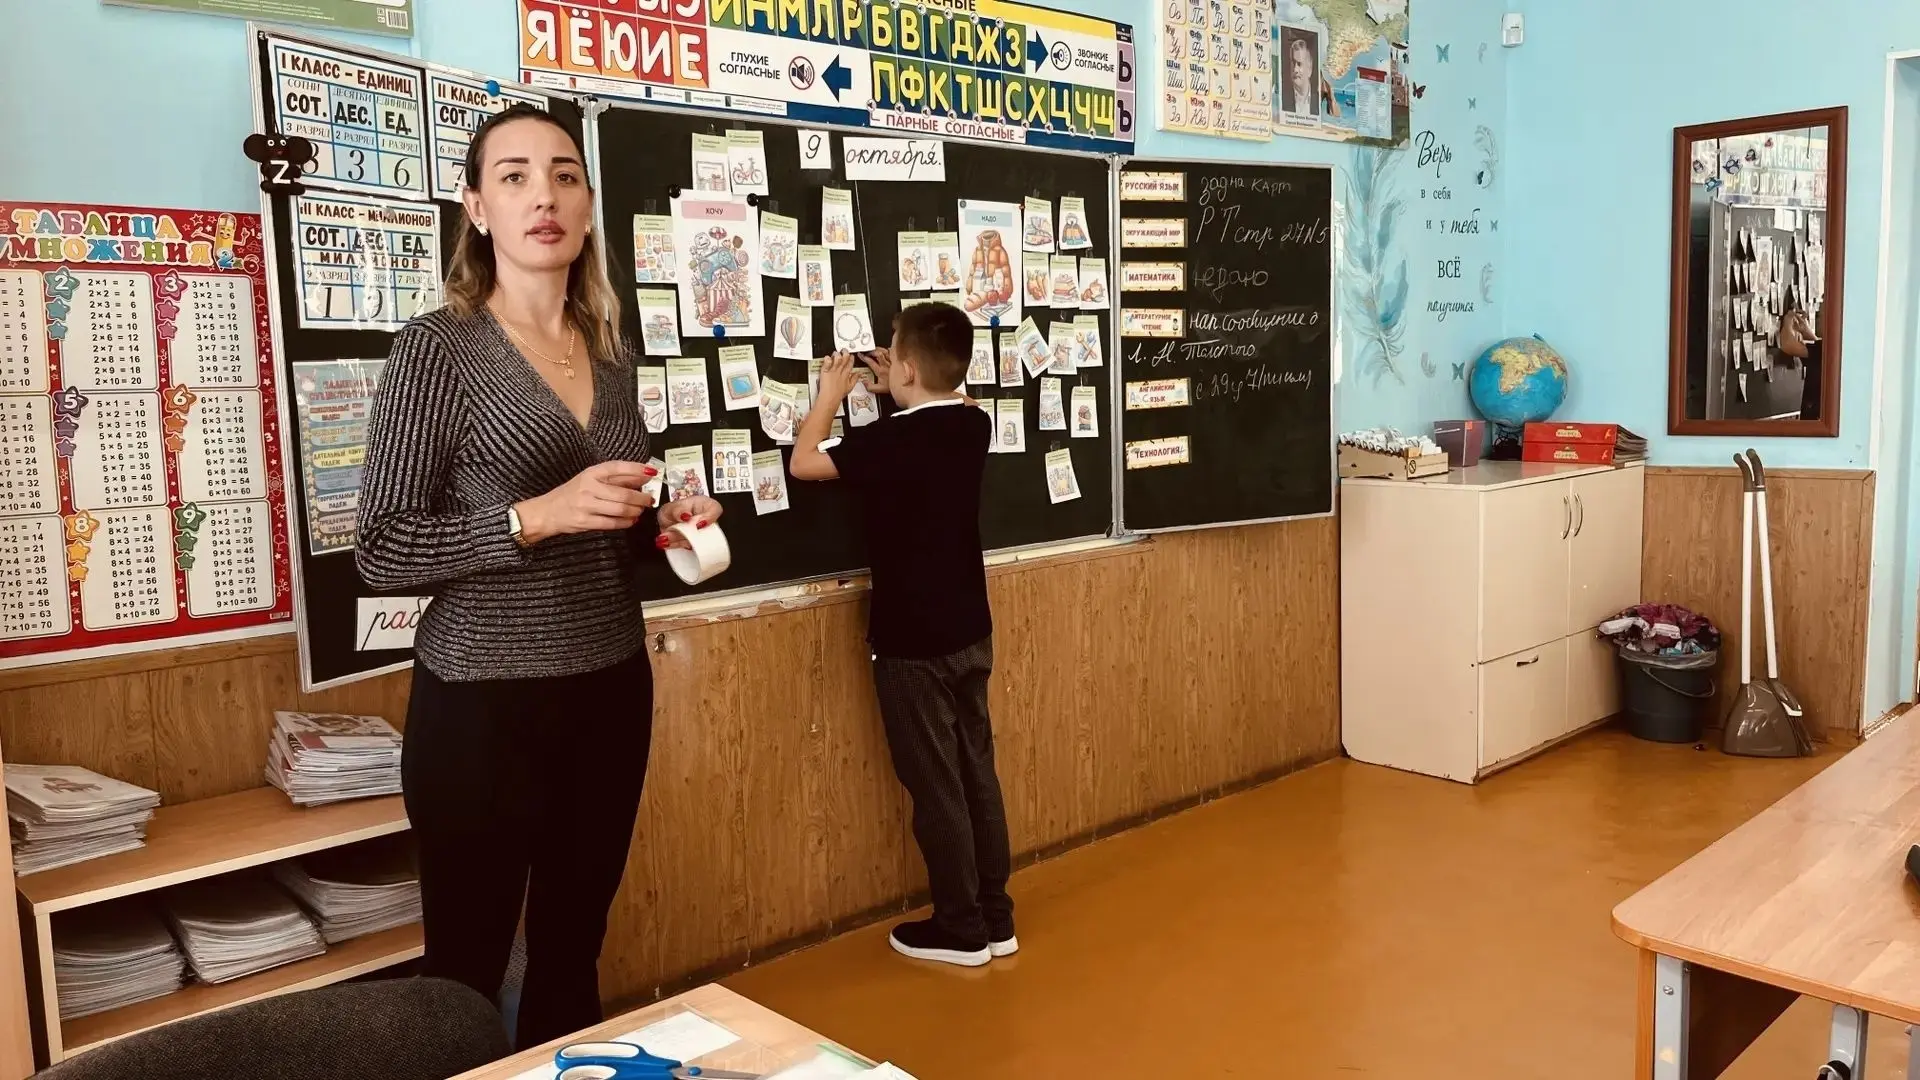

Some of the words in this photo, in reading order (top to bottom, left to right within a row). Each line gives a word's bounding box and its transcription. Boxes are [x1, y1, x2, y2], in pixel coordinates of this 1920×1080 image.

[731, 51, 769, 66] ГЛУХИЕ
[1077, 48, 1109, 62] ЗВОНКИЕ
[719, 62, 781, 81] СОГЛАСНЫЕ
[1074, 58, 1115, 73] СОГЛАСНЫЕ
[291, 54, 341, 79] КЛАСС
[357, 70, 412, 97] ЕДИНИЦ
[288, 78, 320, 92] СОТНИ
[286, 92, 327, 117] СОТ.
[451, 86, 488, 107] КЛАСС
[334, 101, 372, 126] ДЕС.
[440, 106, 471, 128] СОТ.
[296, 124, 330, 138] РАЗРЯД
[385, 111, 412, 135] ЕД.
[885, 114, 939, 132] ПАРНЫЕ
[945, 121, 1015, 141] СОГЛАСНЫЕ
[344, 132, 375, 145] РАЗРЯД
[388, 140, 418, 152] РАЗРЯД
[805, 134, 821, 159] 9
[1415, 130, 1452, 178] Верь
[270, 160, 291, 184] Z
[348, 150, 365, 181] 3
[393, 158, 410, 187] 6
[1125, 182, 1157, 191] РУССКИЙ
[1160, 183, 1180, 192] ЯЗЫК
[1421, 189, 1426, 198] в
[1433, 187, 1451, 199] себя
[316, 204, 355, 219] КЛАСС
[705, 207, 723, 215] ХОЧУ
[981, 215, 997, 223] НАДО
[11, 209, 183, 241] ТАБЛИЦА
[1426, 220, 1432, 229] и
[1440, 220, 1445, 233] у
[1450, 208, 1481, 234] тебя
[306, 226, 345, 248] СОТ.
[1126, 228, 1168, 237] ОКРУЖАЮЩИЙ
[402, 235, 428, 256] ЕД.
[1438, 256, 1461, 278] ВСЁ
[54, 274, 70, 291] 2
[164, 276, 178, 292] 3
[1129, 273, 1176, 282] МАТЕМАТИКА
[1131, 313, 1172, 321] ЛИТЕРАТУРНОЕ
[1427, 300, 1474, 322] получится
[1139, 384, 1176, 393] АНГЛИЙСКИЙ
[62, 392, 78, 409] 5
[172, 391, 190, 407] 6
[1135, 446, 1181, 459] ТЕХНОЛОГИЯ
[74, 516, 90, 535] 8
[182, 509, 197, 525] 9
